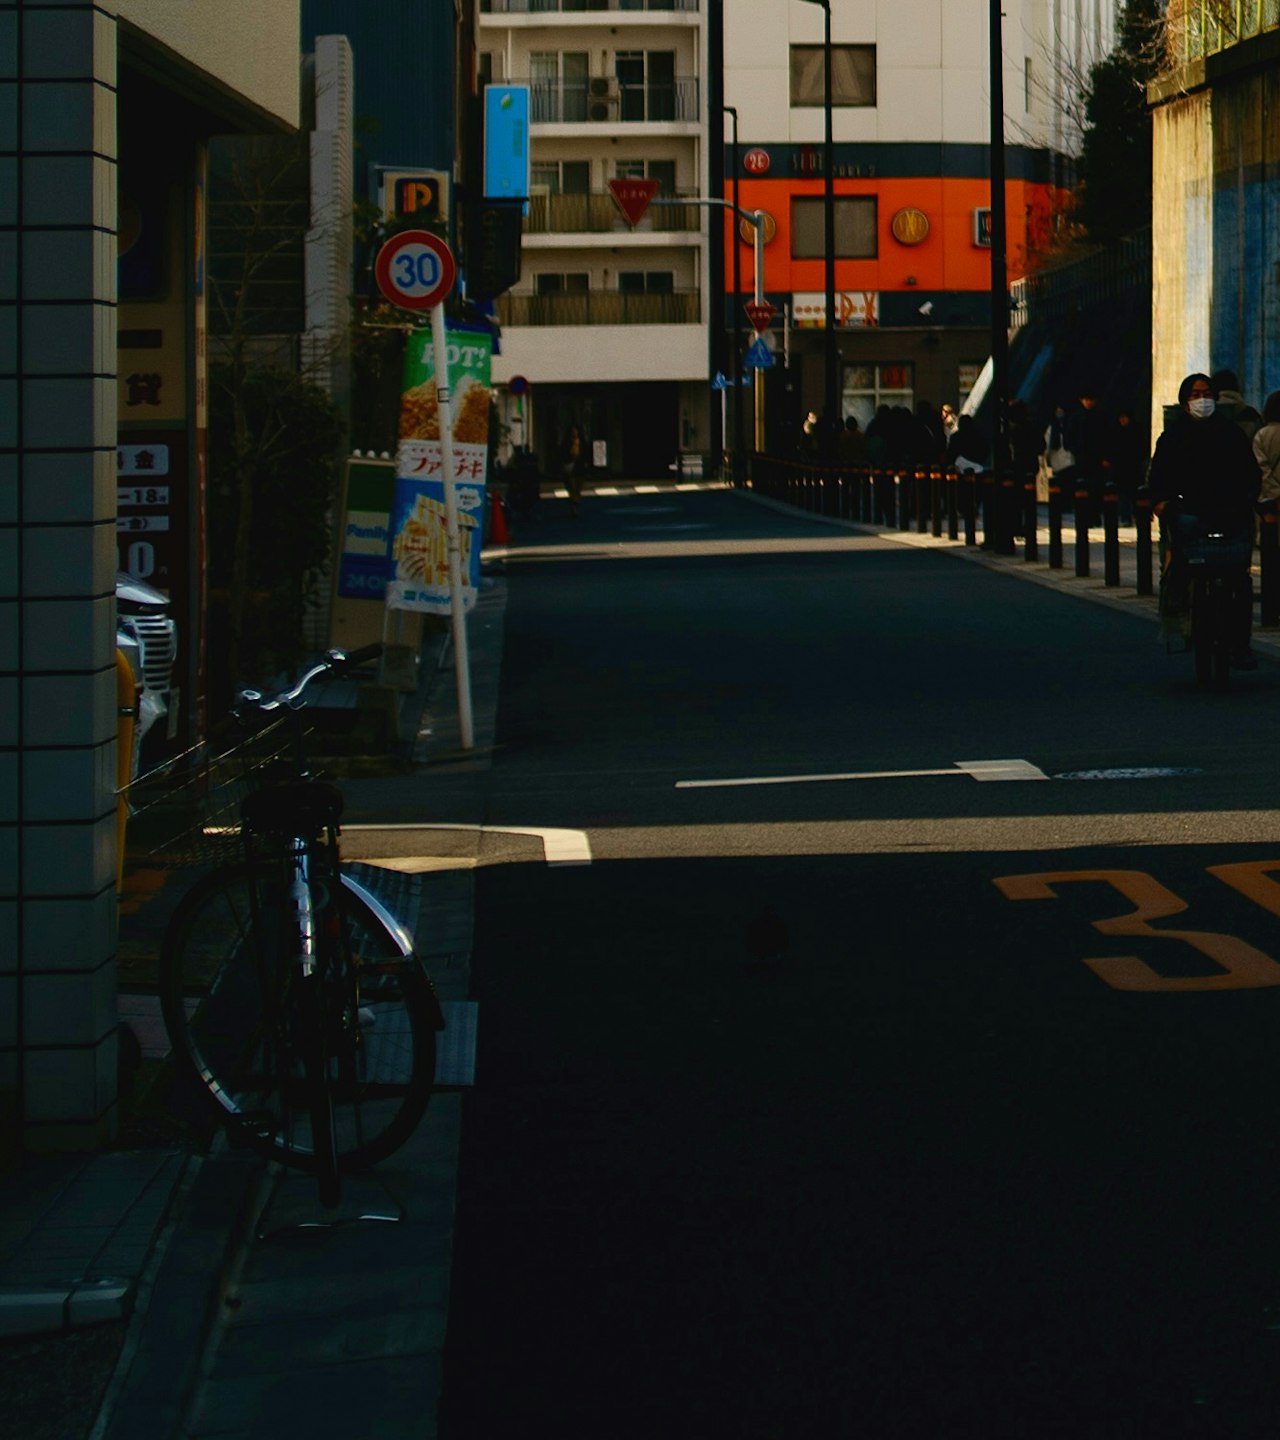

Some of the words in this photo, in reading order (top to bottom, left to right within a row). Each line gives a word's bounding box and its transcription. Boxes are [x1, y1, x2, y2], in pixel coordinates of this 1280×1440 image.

[395, 252, 439, 289] 30
[411, 457, 483, 479] ファチキ
